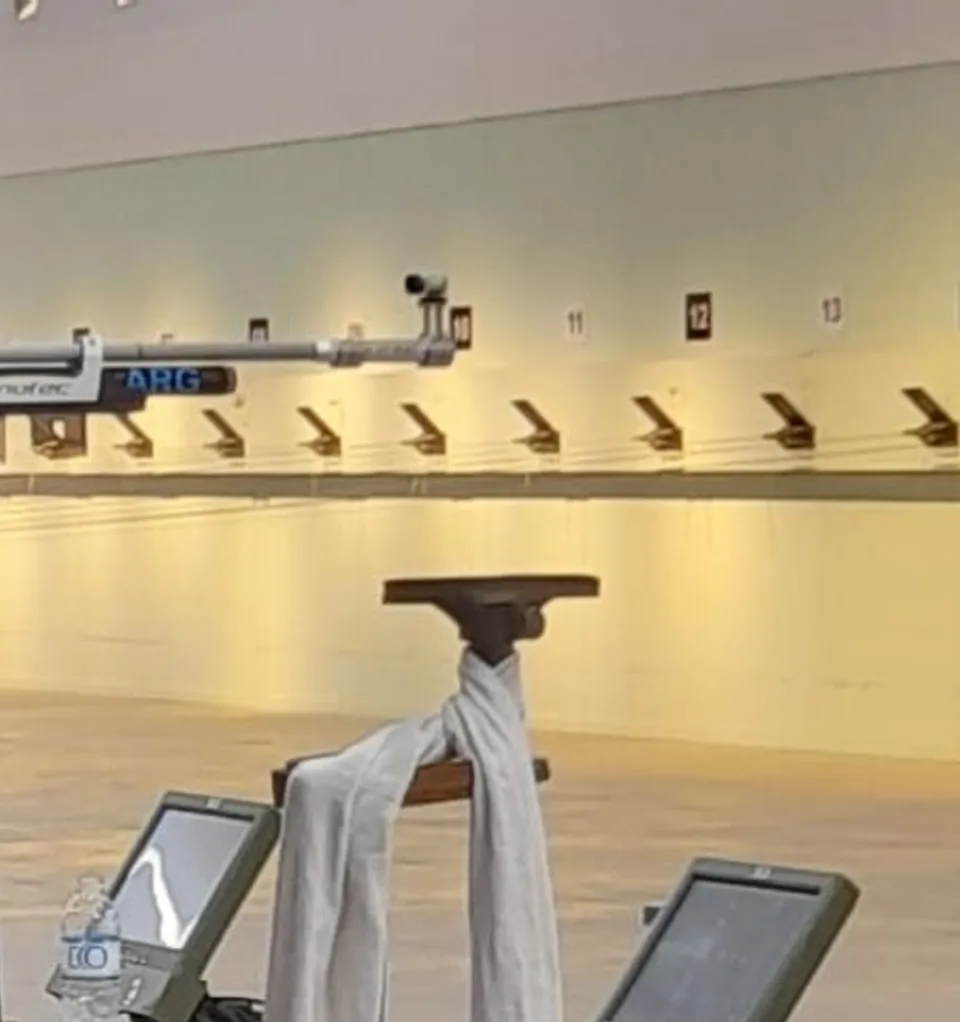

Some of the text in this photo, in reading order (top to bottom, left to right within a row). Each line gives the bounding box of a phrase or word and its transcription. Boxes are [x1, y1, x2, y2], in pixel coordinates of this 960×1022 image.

[567, 310, 584, 335] 11
[690, 302, 711, 331] 12
[125, 368, 201, 392] ARG
